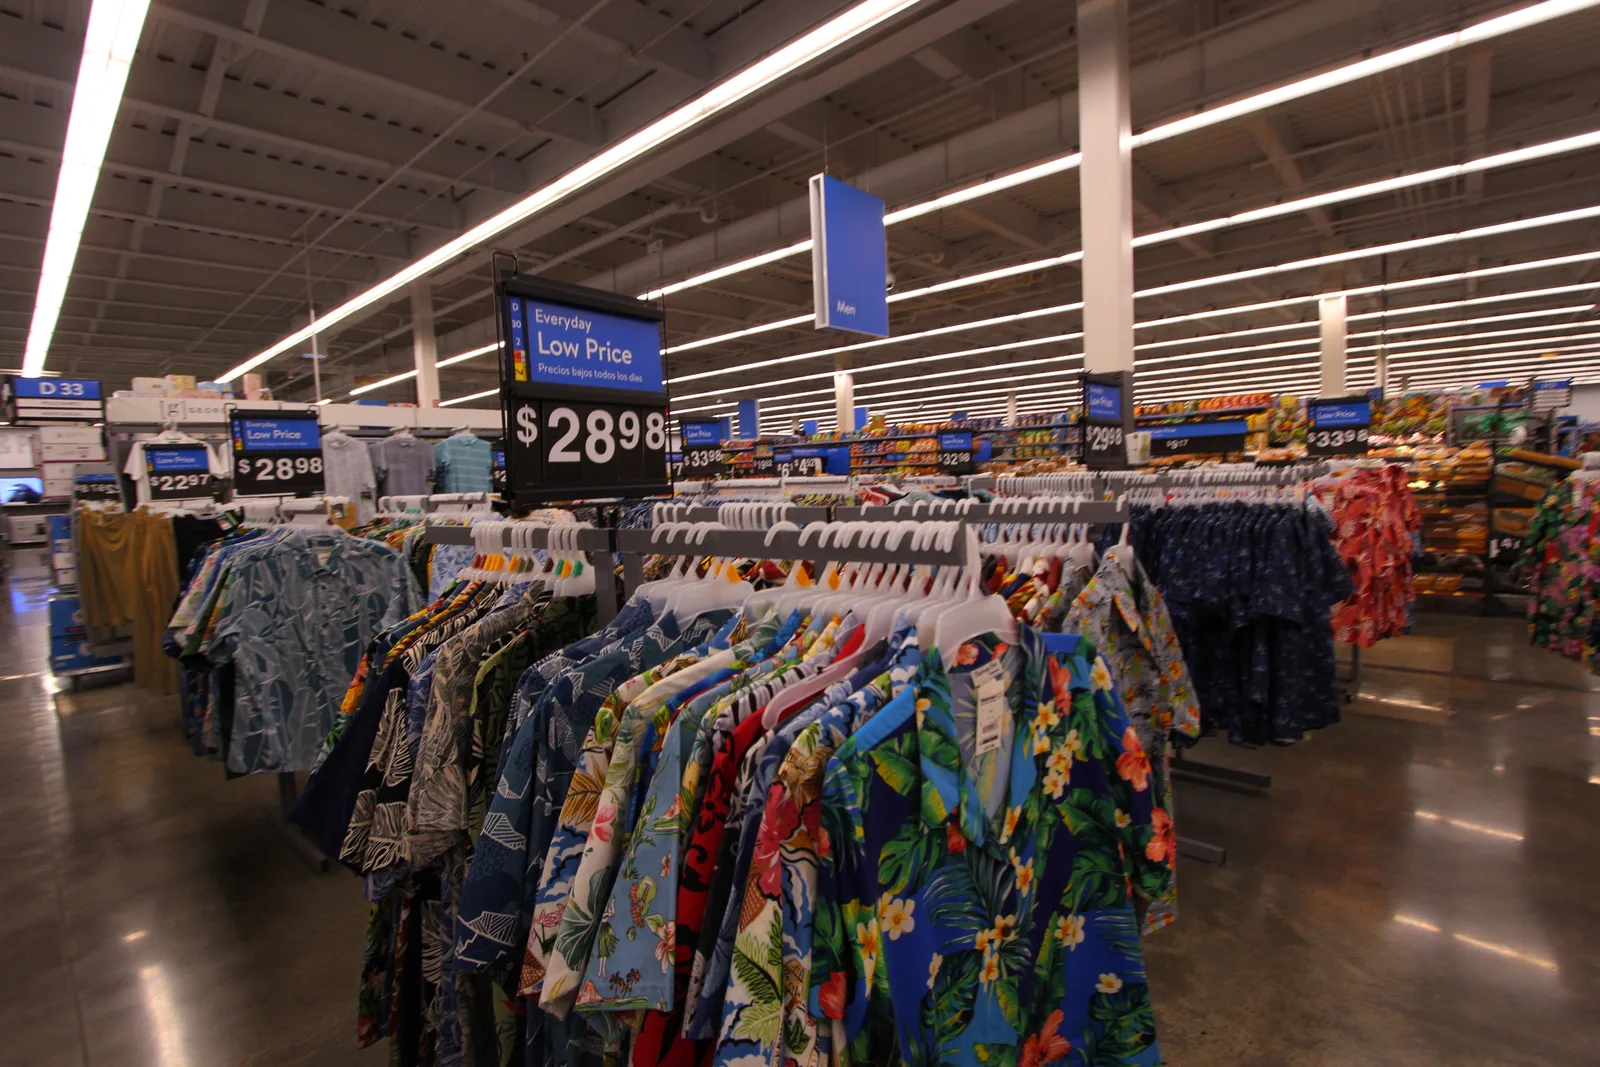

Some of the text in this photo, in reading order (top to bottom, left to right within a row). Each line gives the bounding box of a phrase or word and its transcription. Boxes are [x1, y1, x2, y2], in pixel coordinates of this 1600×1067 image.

[512, 303, 519, 312] D
[836, 300, 856, 316] Men
[535, 308, 592, 334] Everyday
[537, 331, 633, 365] Low Price
[538, 362, 571, 376] Precios
[571, 366, 593, 379] bajos
[594, 370, 616, 380] todos
[617, 371, 627, 381] los
[38, 382, 84, 395] D 33
[247, 429, 302, 439] Low Price
